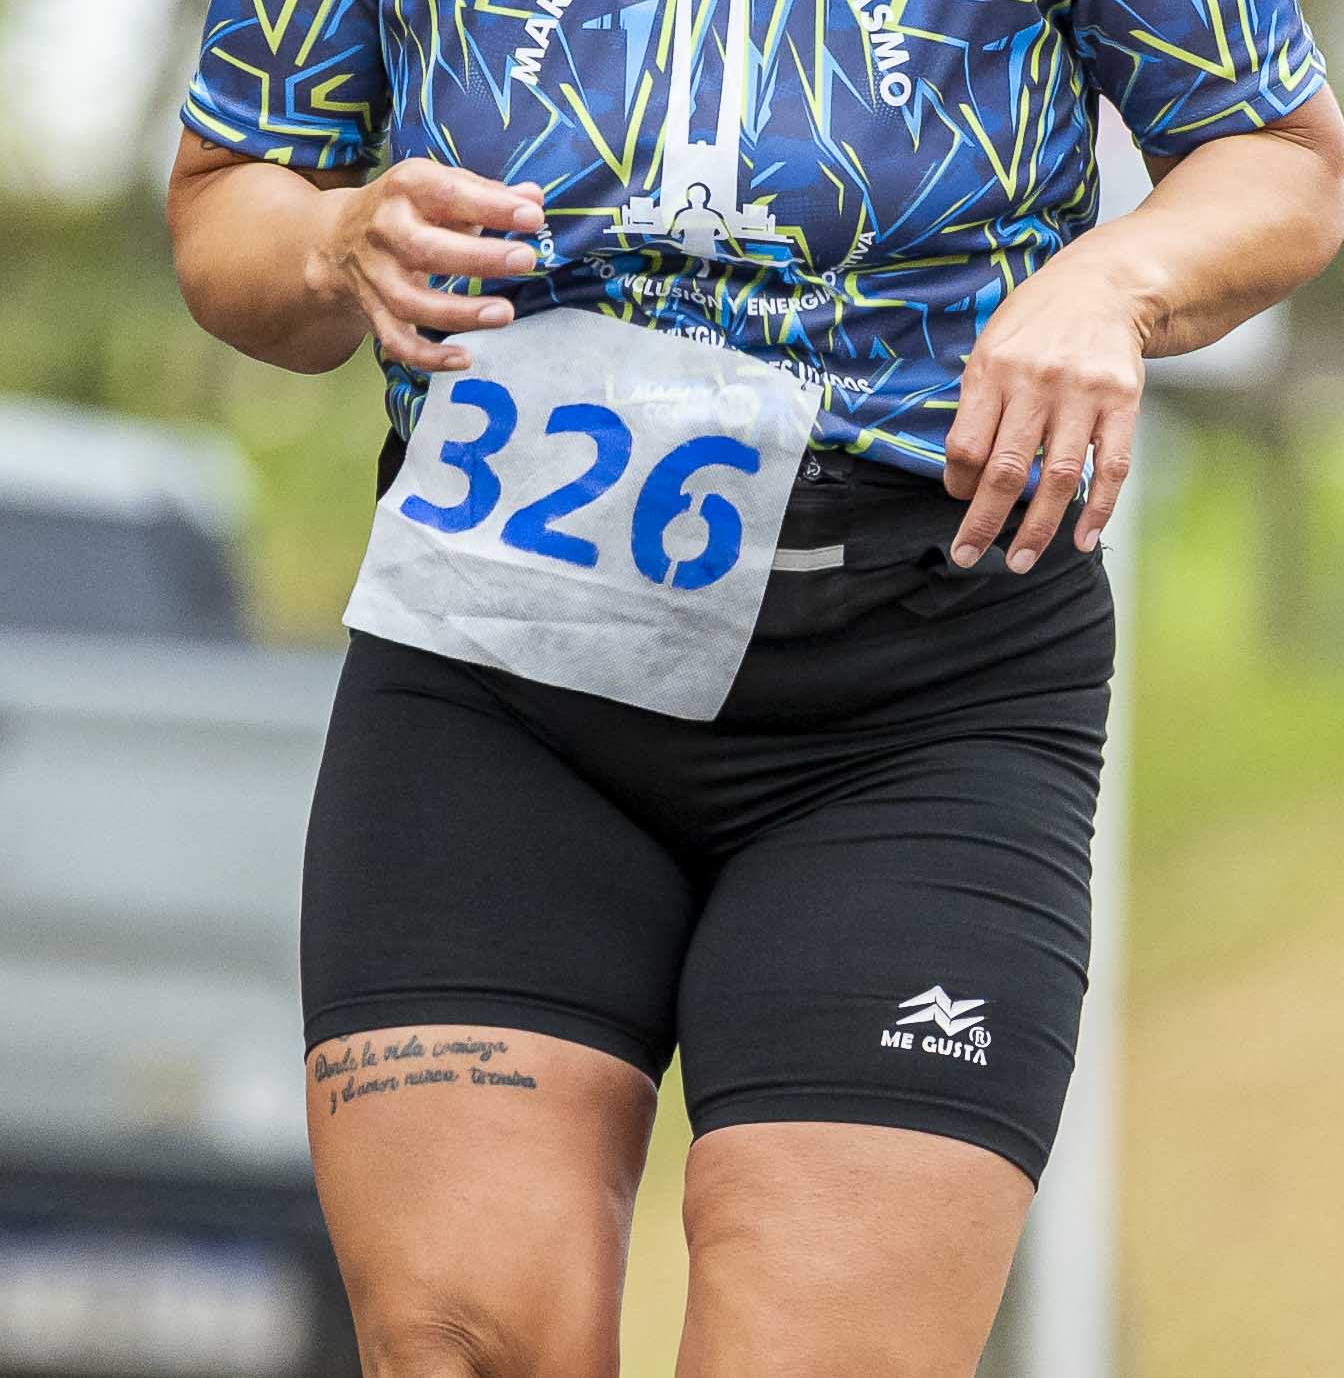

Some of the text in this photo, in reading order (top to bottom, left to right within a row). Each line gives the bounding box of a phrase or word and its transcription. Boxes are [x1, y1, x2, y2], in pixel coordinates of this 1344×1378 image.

[620, 273, 723, 311] NCLUSIÓN
[400, 378, 760, 590] 326
[361, 1040, 378, 1069] la
[383, 1034, 425, 1062] vida
[880, 1029, 915, 1050] ME
[921, 1035, 988, 1066] GUSTA
